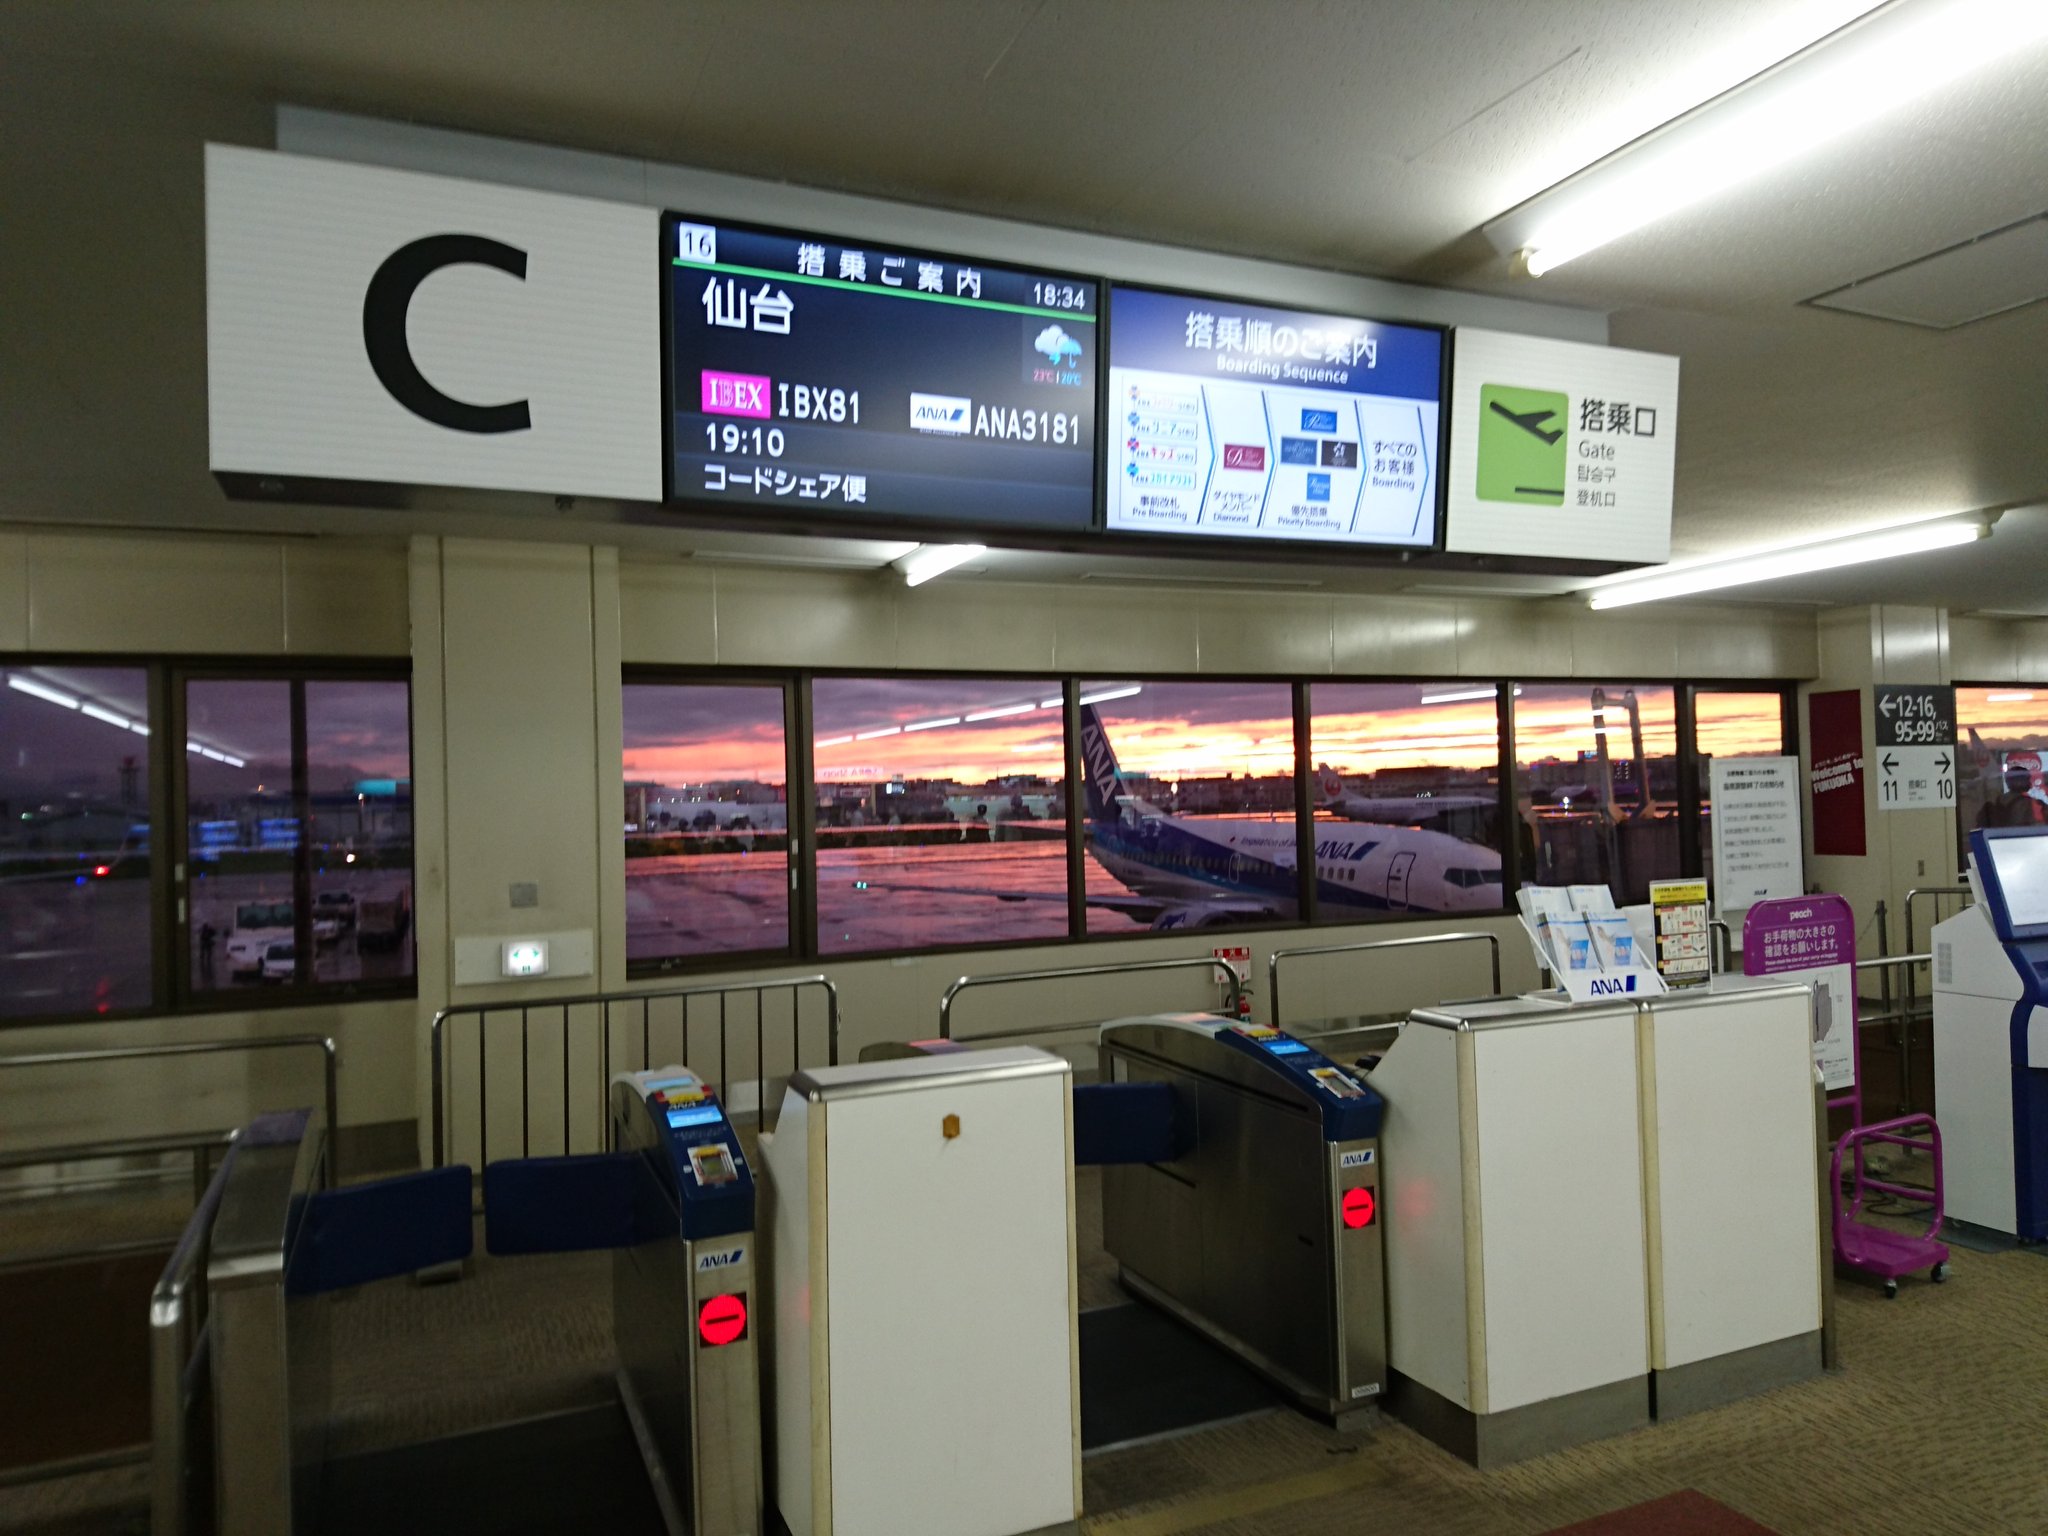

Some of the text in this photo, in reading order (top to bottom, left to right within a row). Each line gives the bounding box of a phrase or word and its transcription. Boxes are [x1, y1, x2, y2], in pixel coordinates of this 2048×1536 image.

[684, 230, 713, 259] 16
[797, 242, 982, 300] 搭乗ご案内
[702, 275, 795, 335] 仙台
[1033, 281, 1086, 310] 18:34
[362, 232, 532, 435] C
[1185, 310, 1378, 369] 搭乗順のご案内
[1216, 353, 1349, 385] Boarding Sequence
[709, 375, 763, 411] IBEX
[778, 383, 859, 424] IBX81
[915, 405, 948, 421] ANA
[1579, 397, 1657, 438] 搭乗口
[974, 404, 1079, 446] ANA3181
[705, 422, 785, 458] 19:10
[1578, 439, 1616, 461] Gate
[704, 463, 867, 504] コードシェア便
[1372, 476, 1415, 492] Boarding
[1577, 463, 1616, 484] 탑승구
[1576, 488, 1616, 508] 登机口
[1148, 508, 1188, 521] Boarding
[1213, 512, 1250, 524] Diamond
[1305, 518, 1341, 531] Boarding
[1895, 720, 1935, 742] 95-99
[1080, 723, 1118, 807] ANA
[1813, 772, 1855, 794] FUKUOKA
[1883, 780, 1898, 801] 11
[1936, 778, 1953, 800] 10
[1314, 840, 1355, 860] ANA
[1789, 907, 1813, 921] peach
[1764, 924, 1836, 944] お手荷物の大きさの
[1590, 978, 1624, 996] ANA
[1342, 1152, 1363, 1165] ANA
[700, 1254, 729, 1268] ANA
